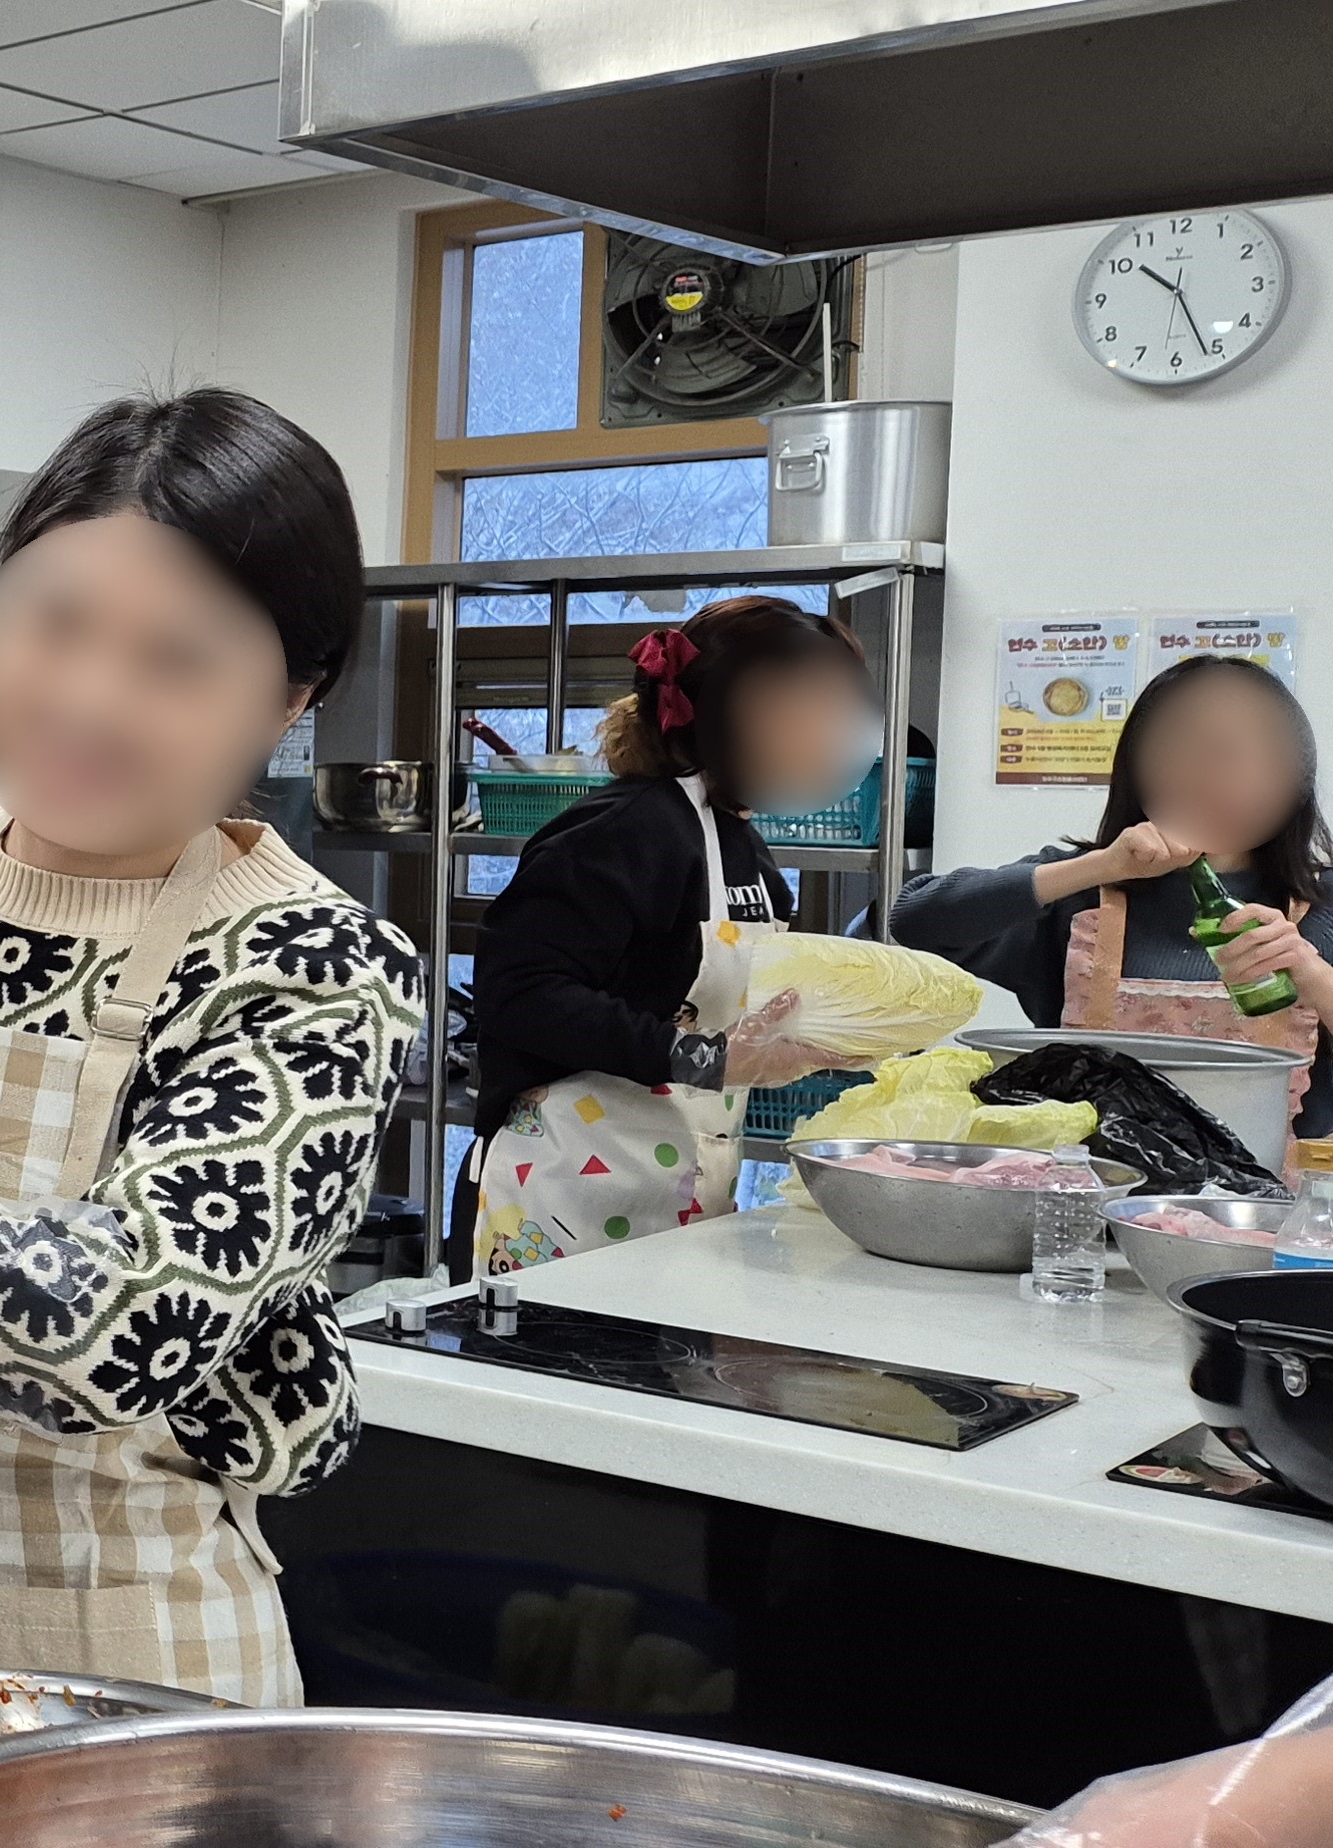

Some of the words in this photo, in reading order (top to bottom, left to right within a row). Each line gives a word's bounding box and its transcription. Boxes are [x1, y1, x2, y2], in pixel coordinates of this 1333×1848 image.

[1169, 218, 1193, 235] 12
[1217, 222, 1225, 239] 1
[1134, 231, 1154, 248] 11
[1240, 243, 1254, 260] 2
[1109, 258, 1133, 275] 10
[1251, 276, 1264, 293] 3
[1095, 293, 1107, 309] 9
[1238, 312, 1251, 328] 4
[1105, 326, 1118, 342] 8
[1135, 345, 1147, 361] 7
[1211, 338, 1223, 354] 5
[1170, 351, 1183, 368] 6
